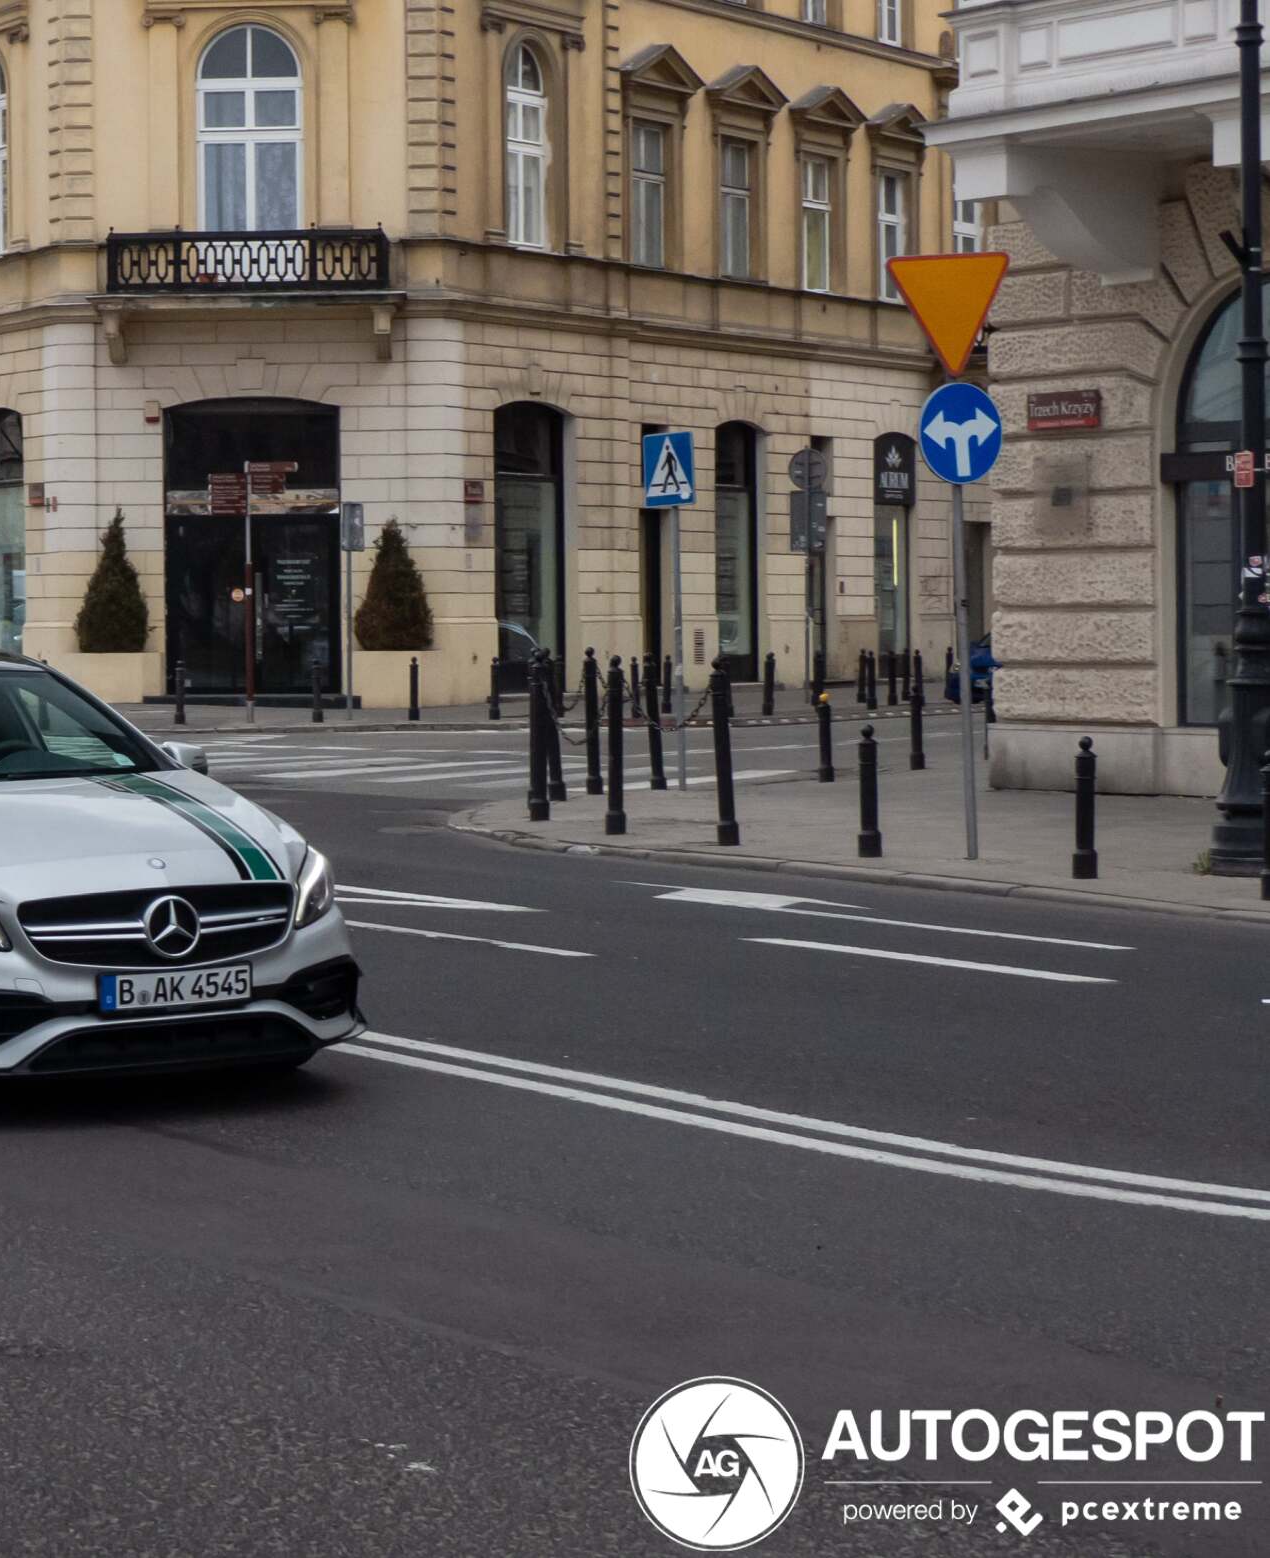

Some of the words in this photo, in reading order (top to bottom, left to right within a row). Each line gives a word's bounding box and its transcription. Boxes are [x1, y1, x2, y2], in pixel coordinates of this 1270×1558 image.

[1029, 401, 1059, 417] Trzech
[119, 979, 135, 1005] B
[153, 976, 186, 1003] AK
[191, 969, 248, 999] 4545
